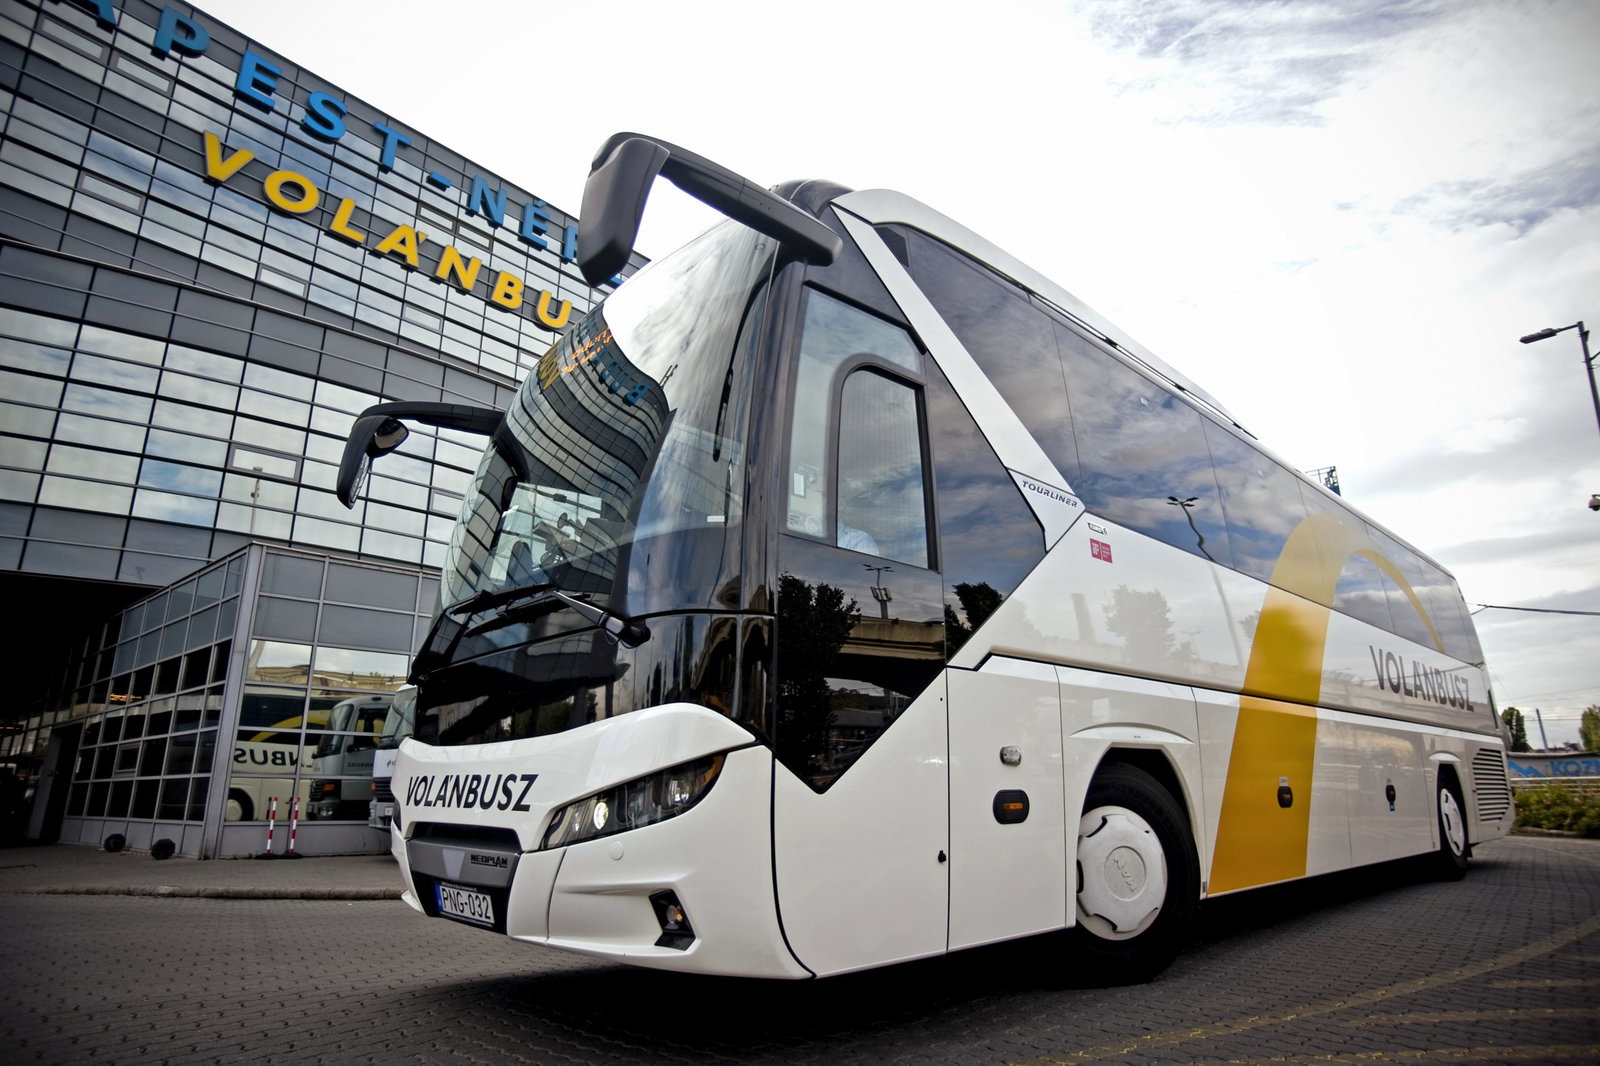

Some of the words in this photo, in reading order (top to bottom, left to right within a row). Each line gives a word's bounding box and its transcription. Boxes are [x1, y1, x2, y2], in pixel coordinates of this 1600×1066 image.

[1022, 480, 1078, 508] TOURLINER
[1549, 759, 1600, 777] KOZ
[470, 853, 508, 868] NEOPLAN
[441, 888, 491, 919] PNG-032
